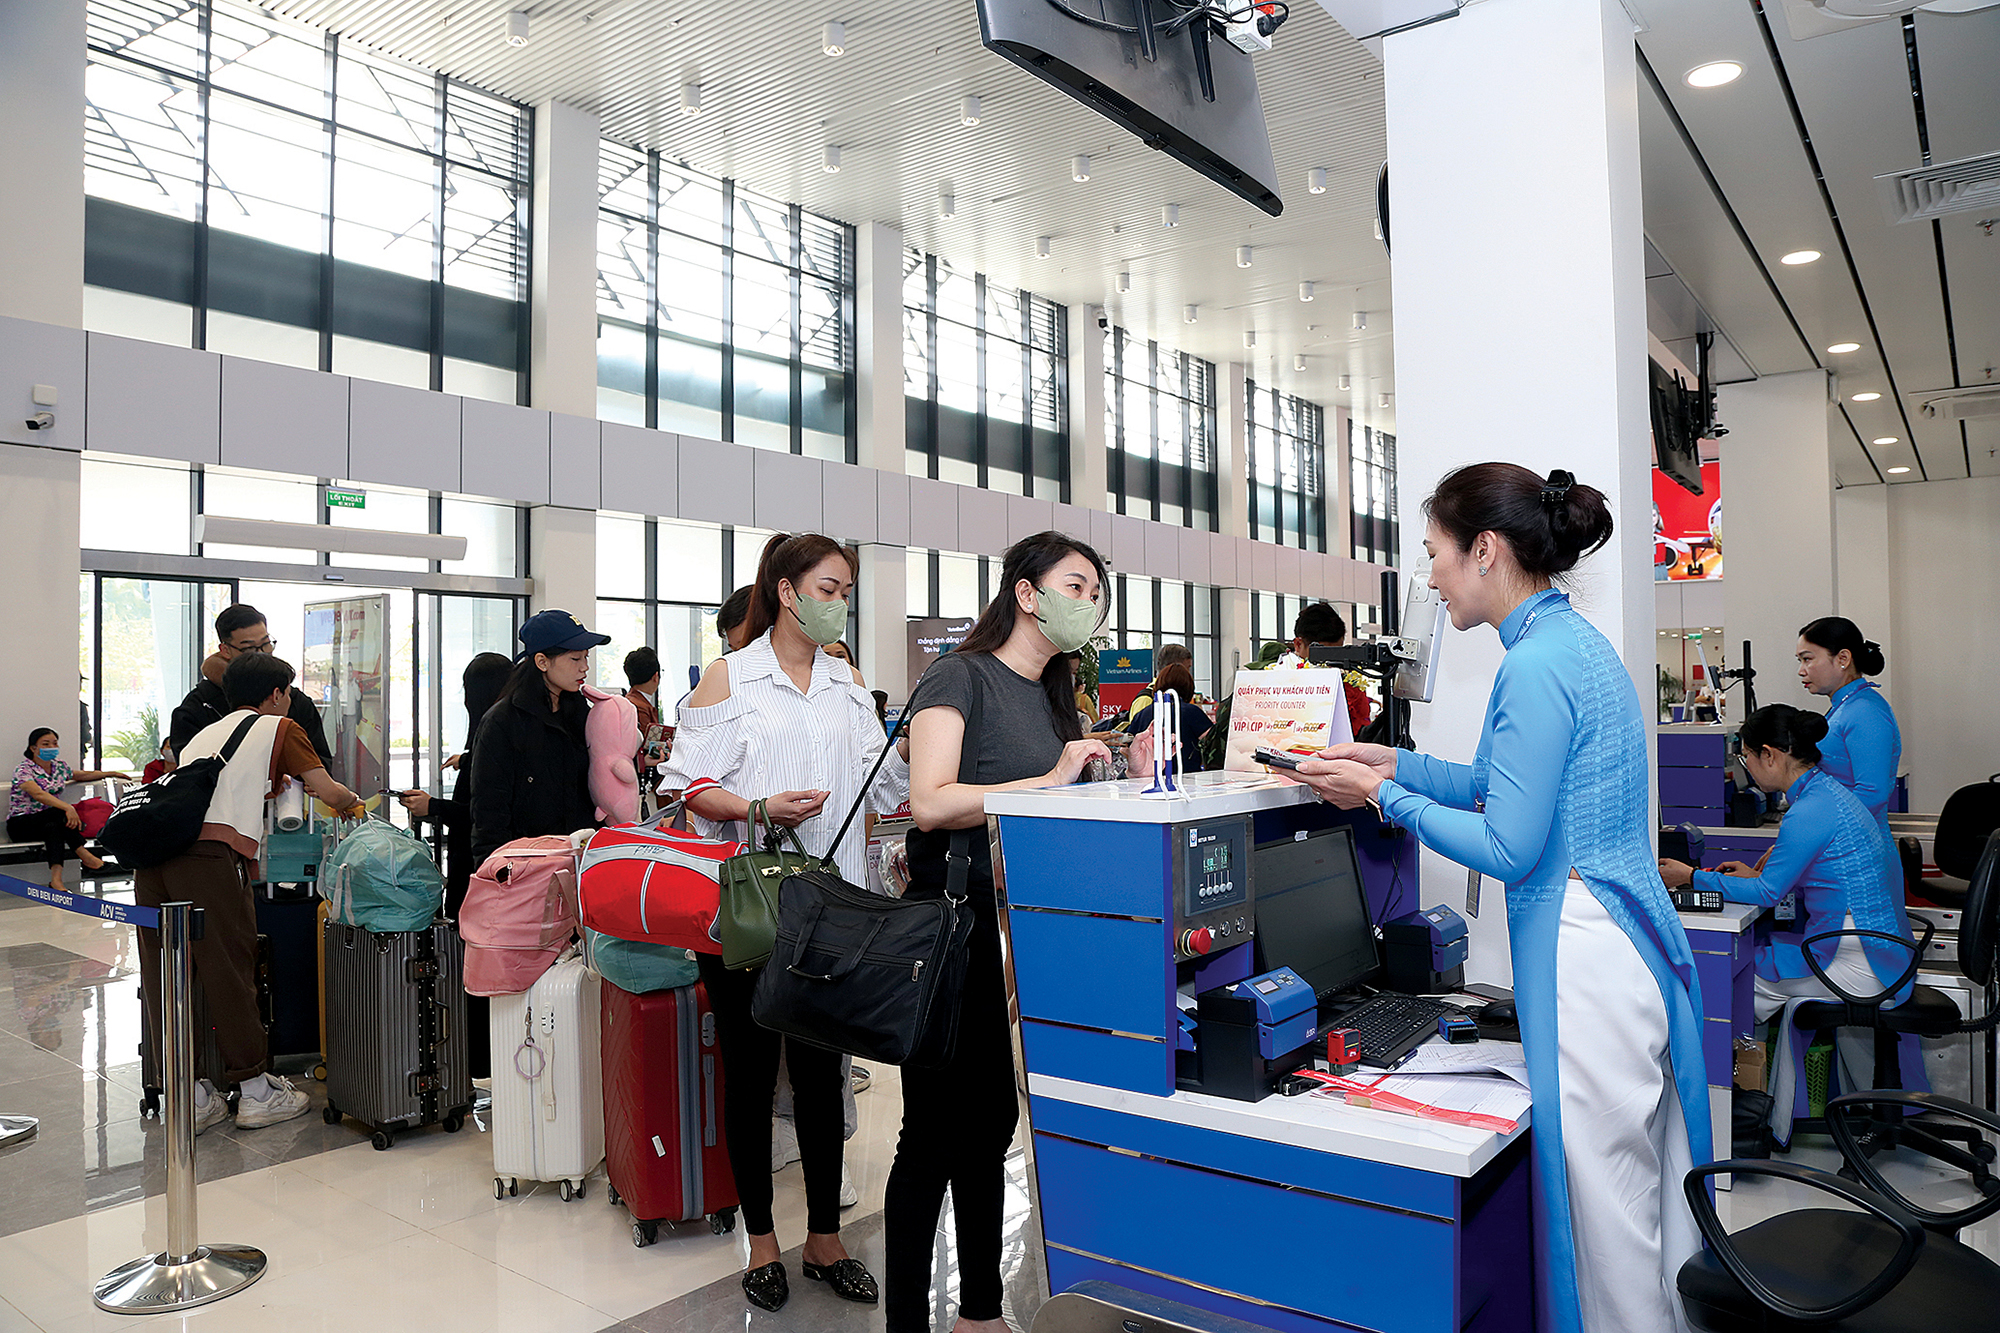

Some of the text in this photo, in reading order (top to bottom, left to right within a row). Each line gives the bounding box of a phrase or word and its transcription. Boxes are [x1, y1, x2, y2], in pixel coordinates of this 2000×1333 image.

[1102, 704, 1122, 713] SKY
[1255, 701, 1306, 709] PRIORITY COUNTER
[1234, 722, 1246, 731] VIP
[1250, 722, 1263, 731] CIP
[27, 887, 74, 906] DIEN BIEN AIRPORT
[100, 903, 115, 919] ACV
